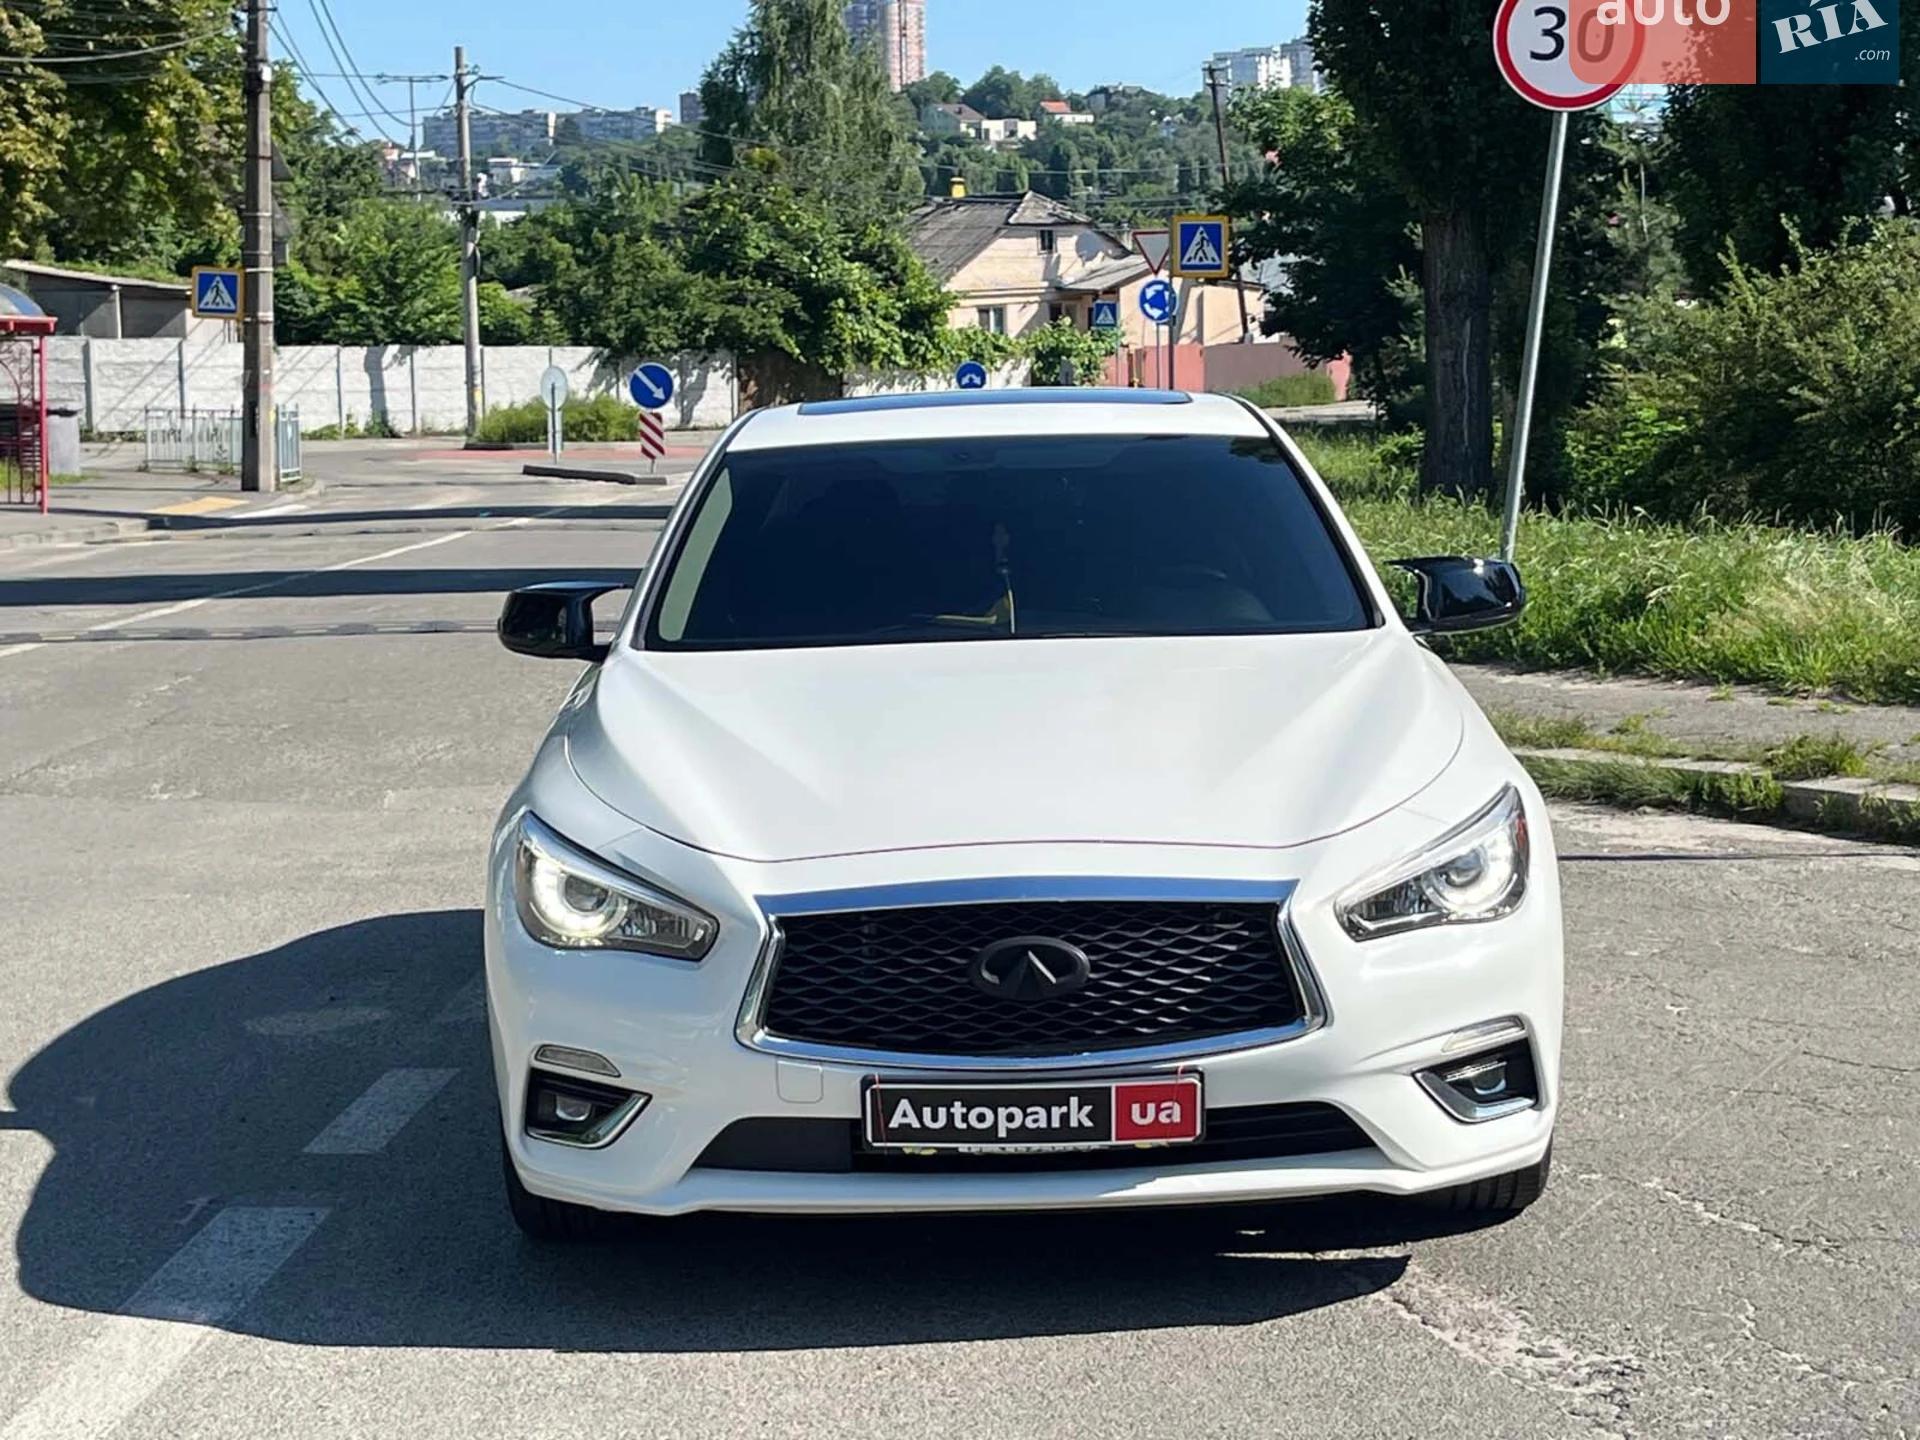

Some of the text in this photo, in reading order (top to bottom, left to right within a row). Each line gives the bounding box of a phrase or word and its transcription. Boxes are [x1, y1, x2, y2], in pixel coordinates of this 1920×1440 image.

[1528, 6, 1615, 63] 30
[888, 1096, 1181, 1138] Autopark ua
